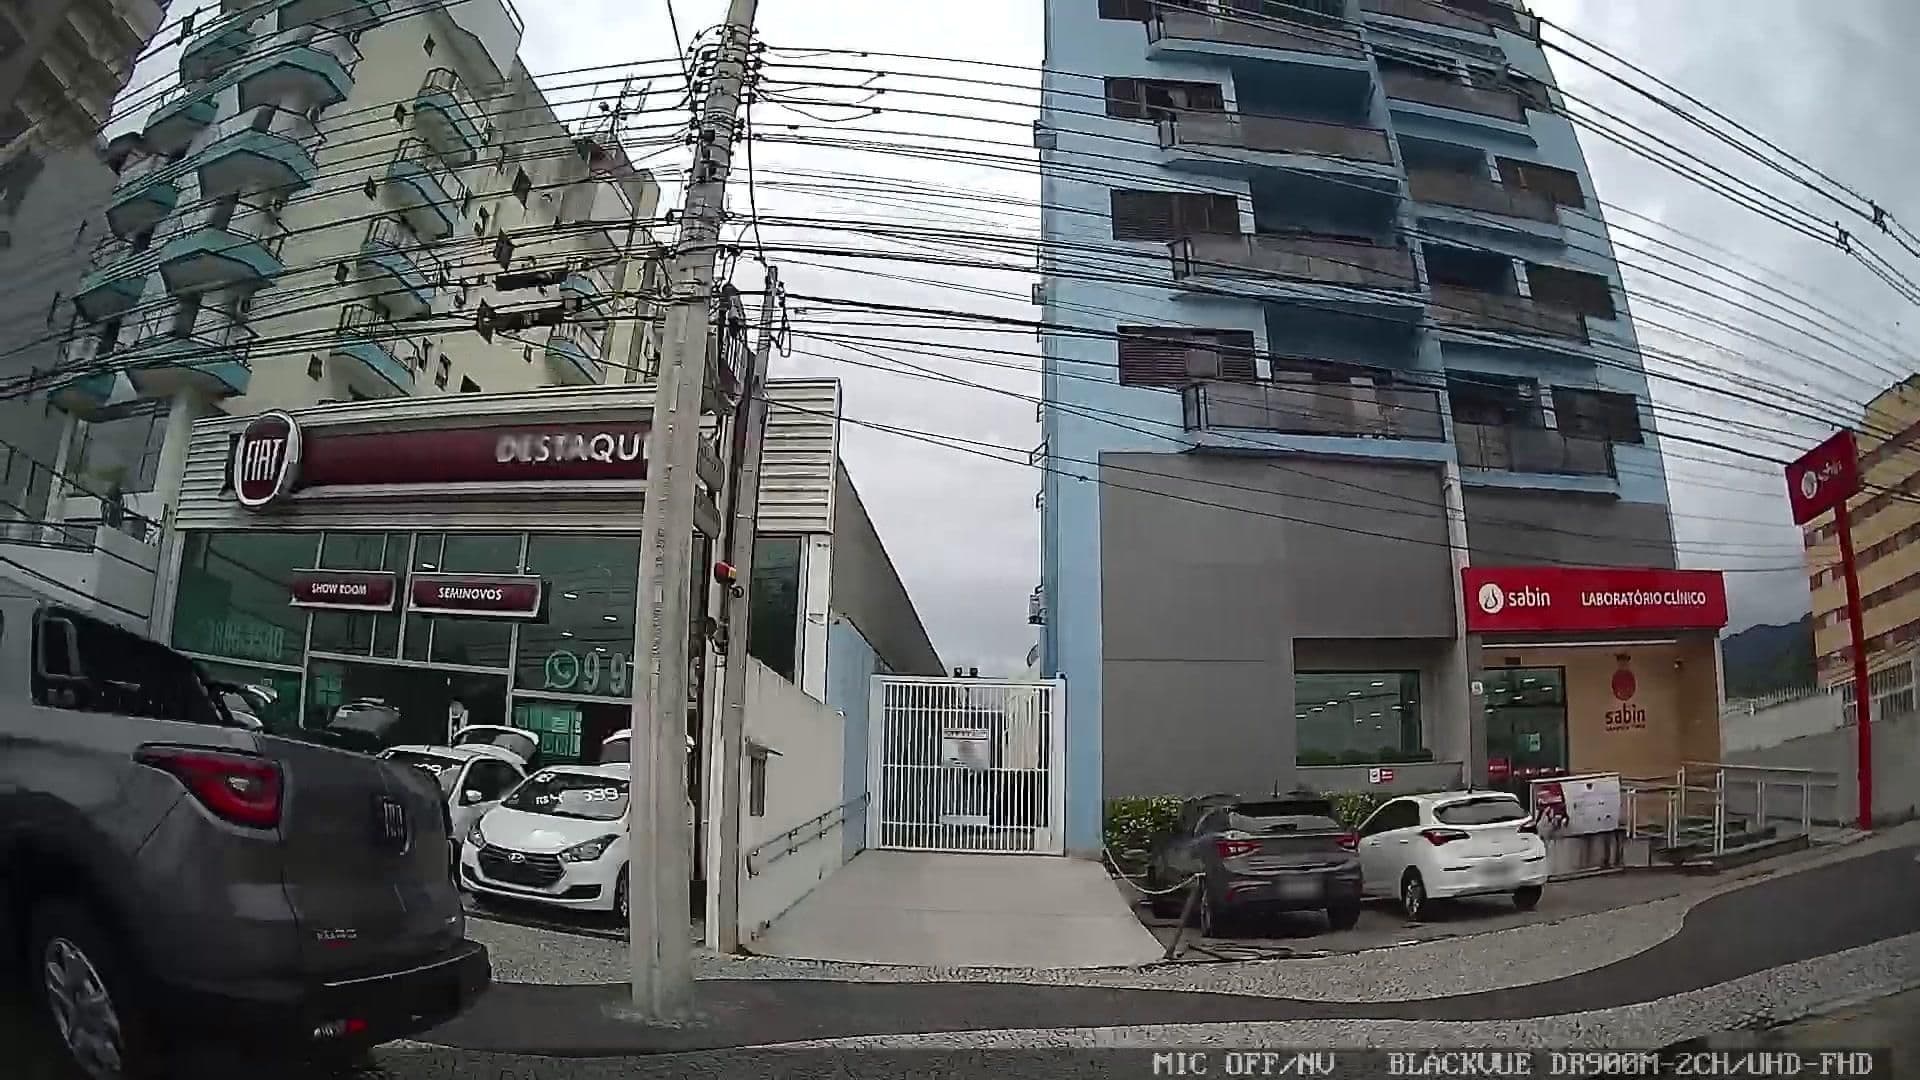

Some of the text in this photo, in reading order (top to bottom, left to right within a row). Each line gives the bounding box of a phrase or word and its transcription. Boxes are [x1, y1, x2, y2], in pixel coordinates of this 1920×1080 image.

[243, 438, 284, 481] FIAT
[311, 583, 367, 596] SHOW ROOM
[438, 587, 503, 600] SEMINOVOS
[1508, 585, 1550, 607] sabin
[1581, 589, 1706, 607] LABORATÓRIO CLÍNICO
[1605, 702, 1646, 725] sabin
